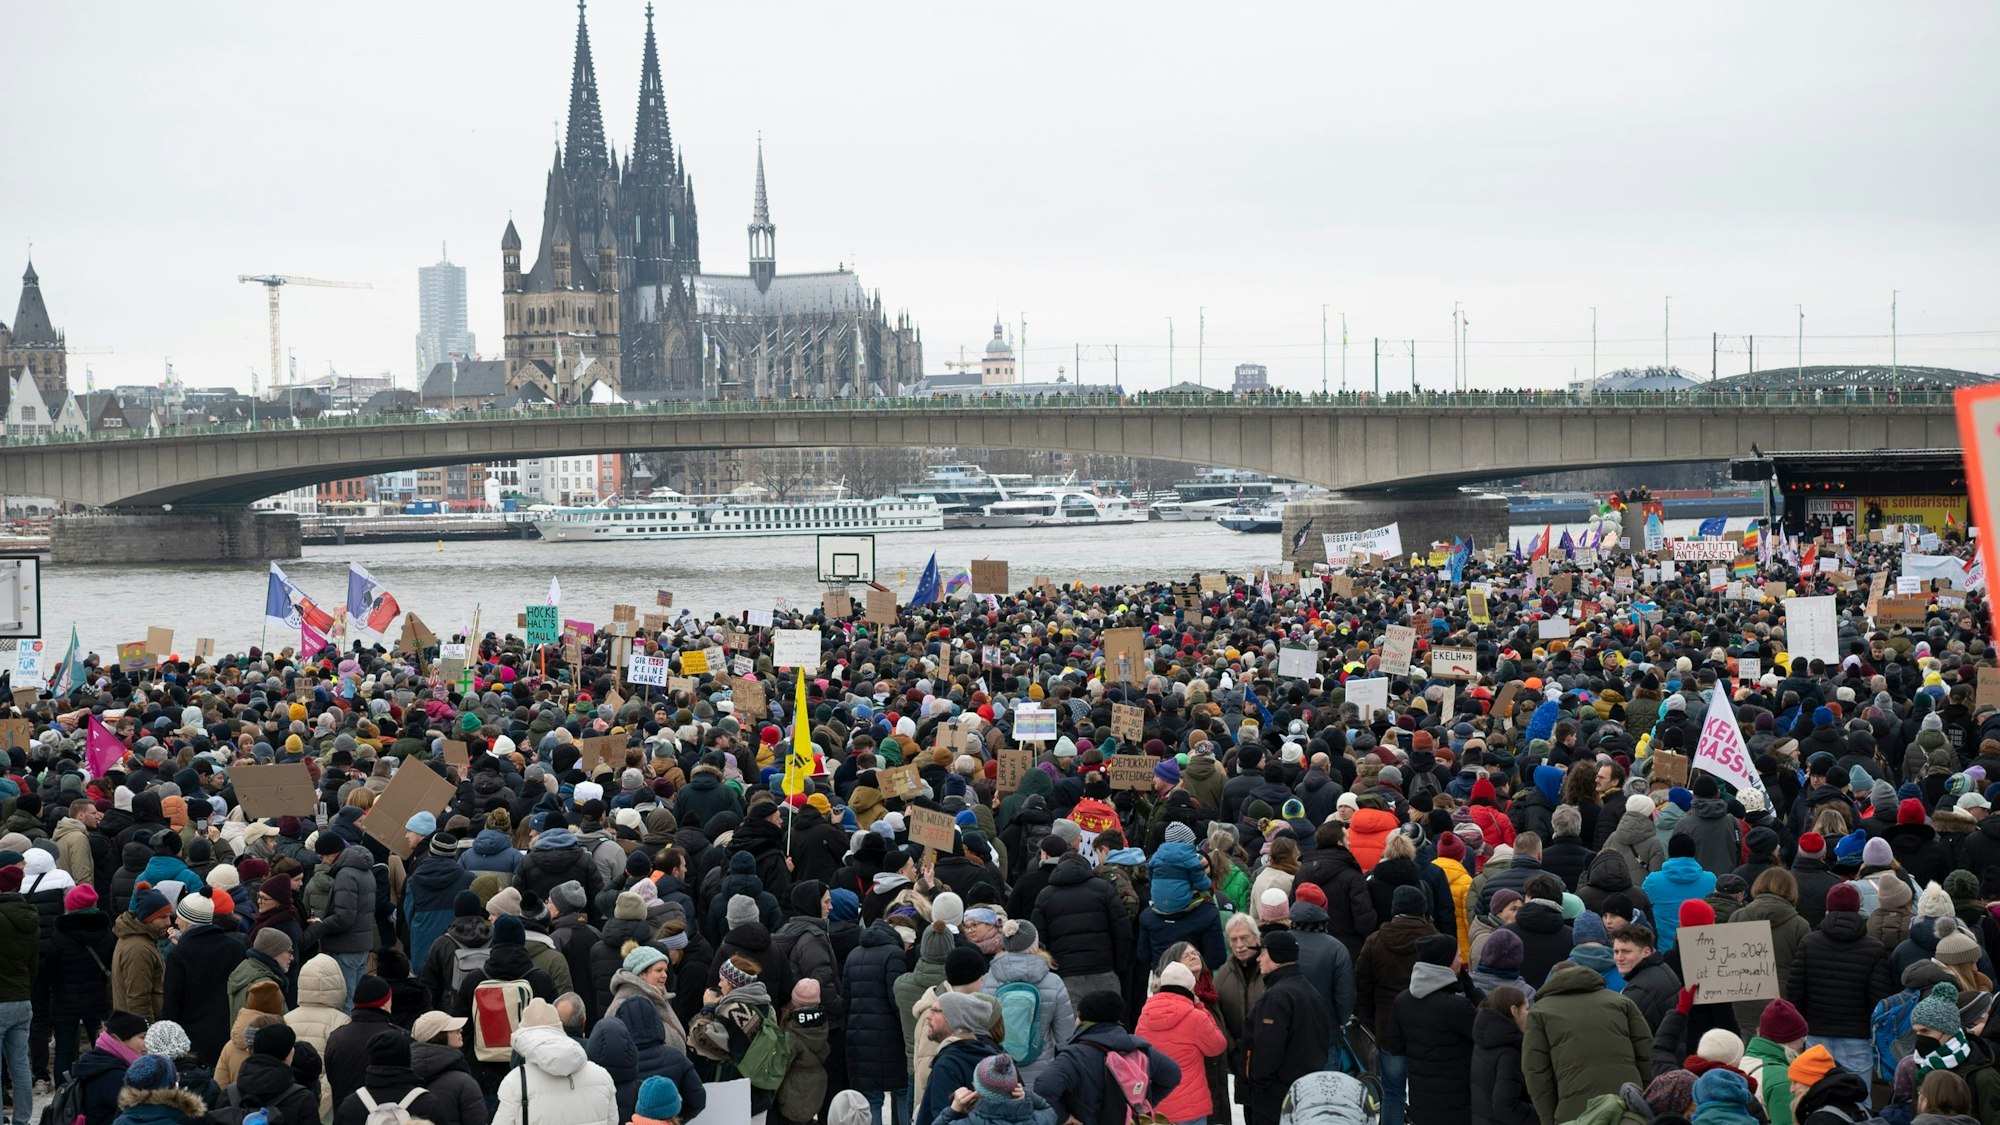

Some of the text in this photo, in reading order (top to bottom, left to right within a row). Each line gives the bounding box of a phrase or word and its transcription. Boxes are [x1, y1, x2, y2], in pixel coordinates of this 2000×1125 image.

[1892, 496, 1960, 508] solidarisch!
[1676, 542, 1734, 550] SIAMO TUTTI
[527, 620, 556, 628] HALT'S
[528, 632, 550, 640] MAUL
[18, 657, 35, 670] FÜR
[634, 656, 646, 664] GIB
[634, 666, 664, 676] KEINE
[633, 675, 663, 684] CHANCE
[1129, 707, 1143, 717] BUNT
[1128, 718, 1143, 728] LAUT
[914, 809, 952, 828] NIE WIEDER
[911, 824, 952, 841] IST JETZT
[1696, 932, 1714, 946] Am
[1720, 946, 1737, 964] Juni
[1741, 942, 1769, 959] 2024
[1696, 962, 1776, 980] ist Europawahl!
[1704, 986, 1722, 999] gegen
